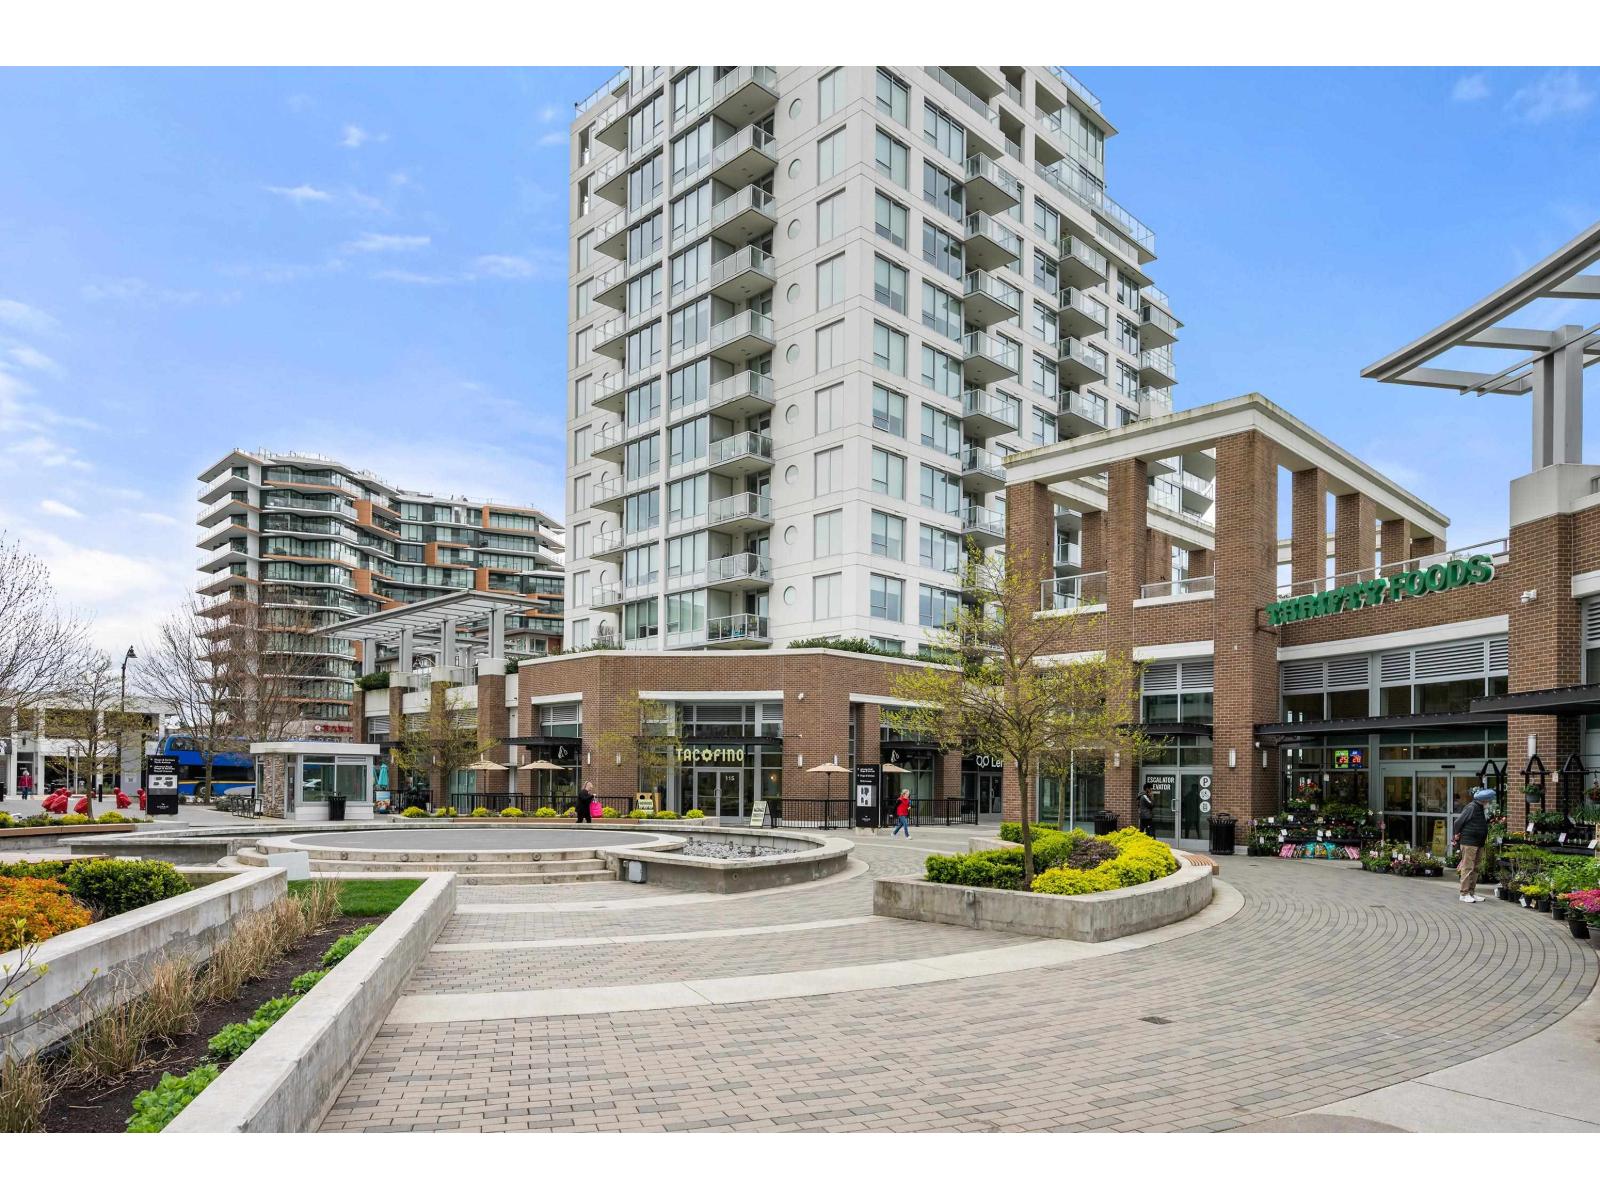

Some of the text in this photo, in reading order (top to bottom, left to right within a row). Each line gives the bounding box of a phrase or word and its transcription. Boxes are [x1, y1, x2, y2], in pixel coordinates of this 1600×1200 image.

[1264, 554, 1494, 627] THRIFTY FOODS
[676, 748, 744, 762] TACOFINO
[1146, 776, 1175, 784] ESCALATOR
[1151, 783, 1171, 791] EVATOR
